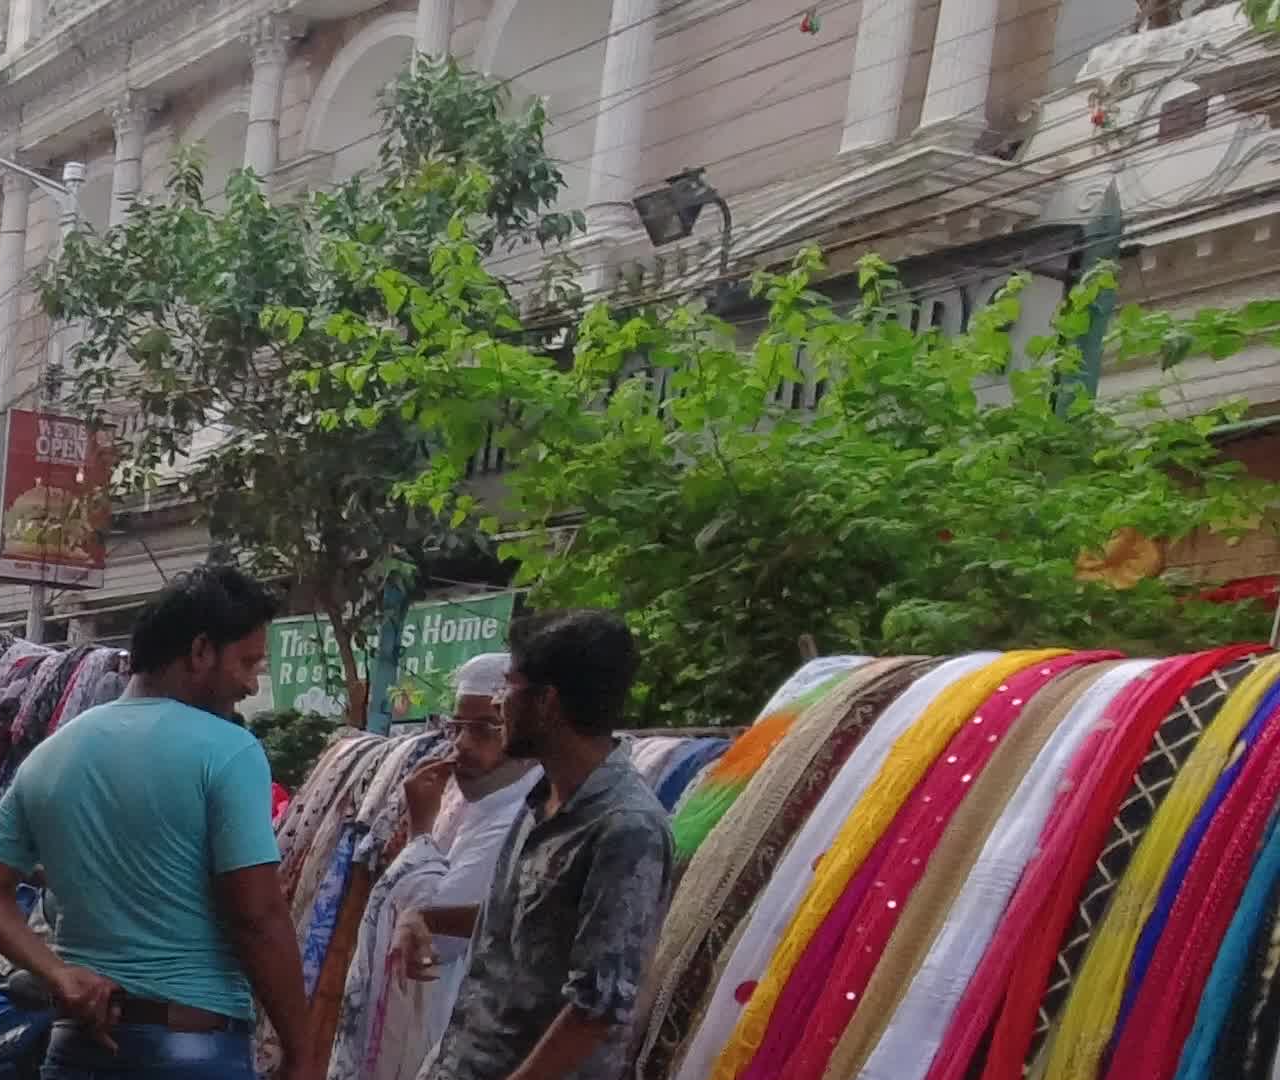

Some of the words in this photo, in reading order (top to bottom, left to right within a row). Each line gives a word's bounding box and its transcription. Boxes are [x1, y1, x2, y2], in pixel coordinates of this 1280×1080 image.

[35, 436, 88, 460] OPEN
[279, 628, 317, 658] The
[421, 613, 498, 645] Home
